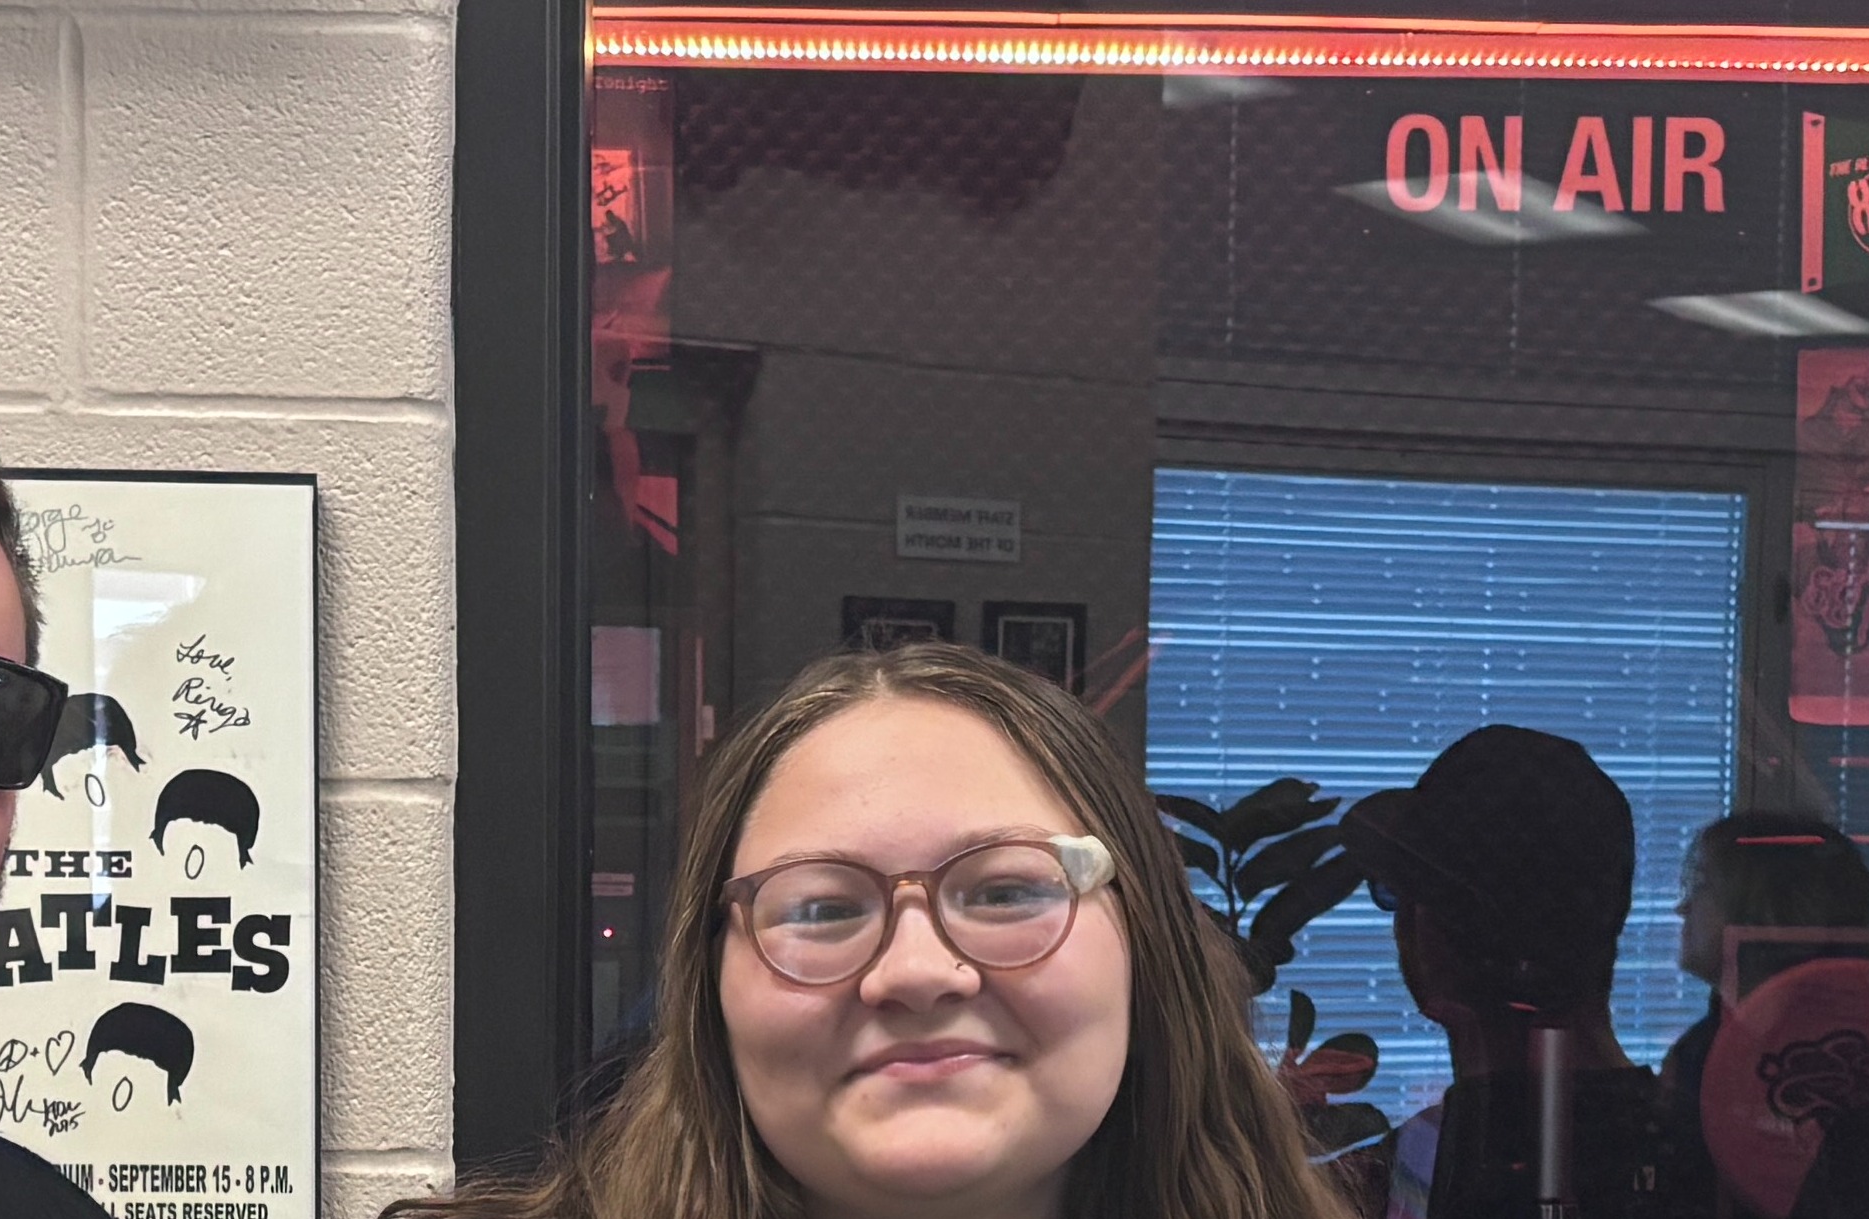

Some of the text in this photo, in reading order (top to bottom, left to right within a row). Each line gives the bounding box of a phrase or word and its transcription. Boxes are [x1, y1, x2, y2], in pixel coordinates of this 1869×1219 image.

[1386, 113, 1726, 213] ON AIR
[4, 849, 132, 879] THE
[108, 1163, 207, 1194] SEPTEMBER
[212, 1165, 231, 1194] 15
[245, 1164, 256, 1194] 8
